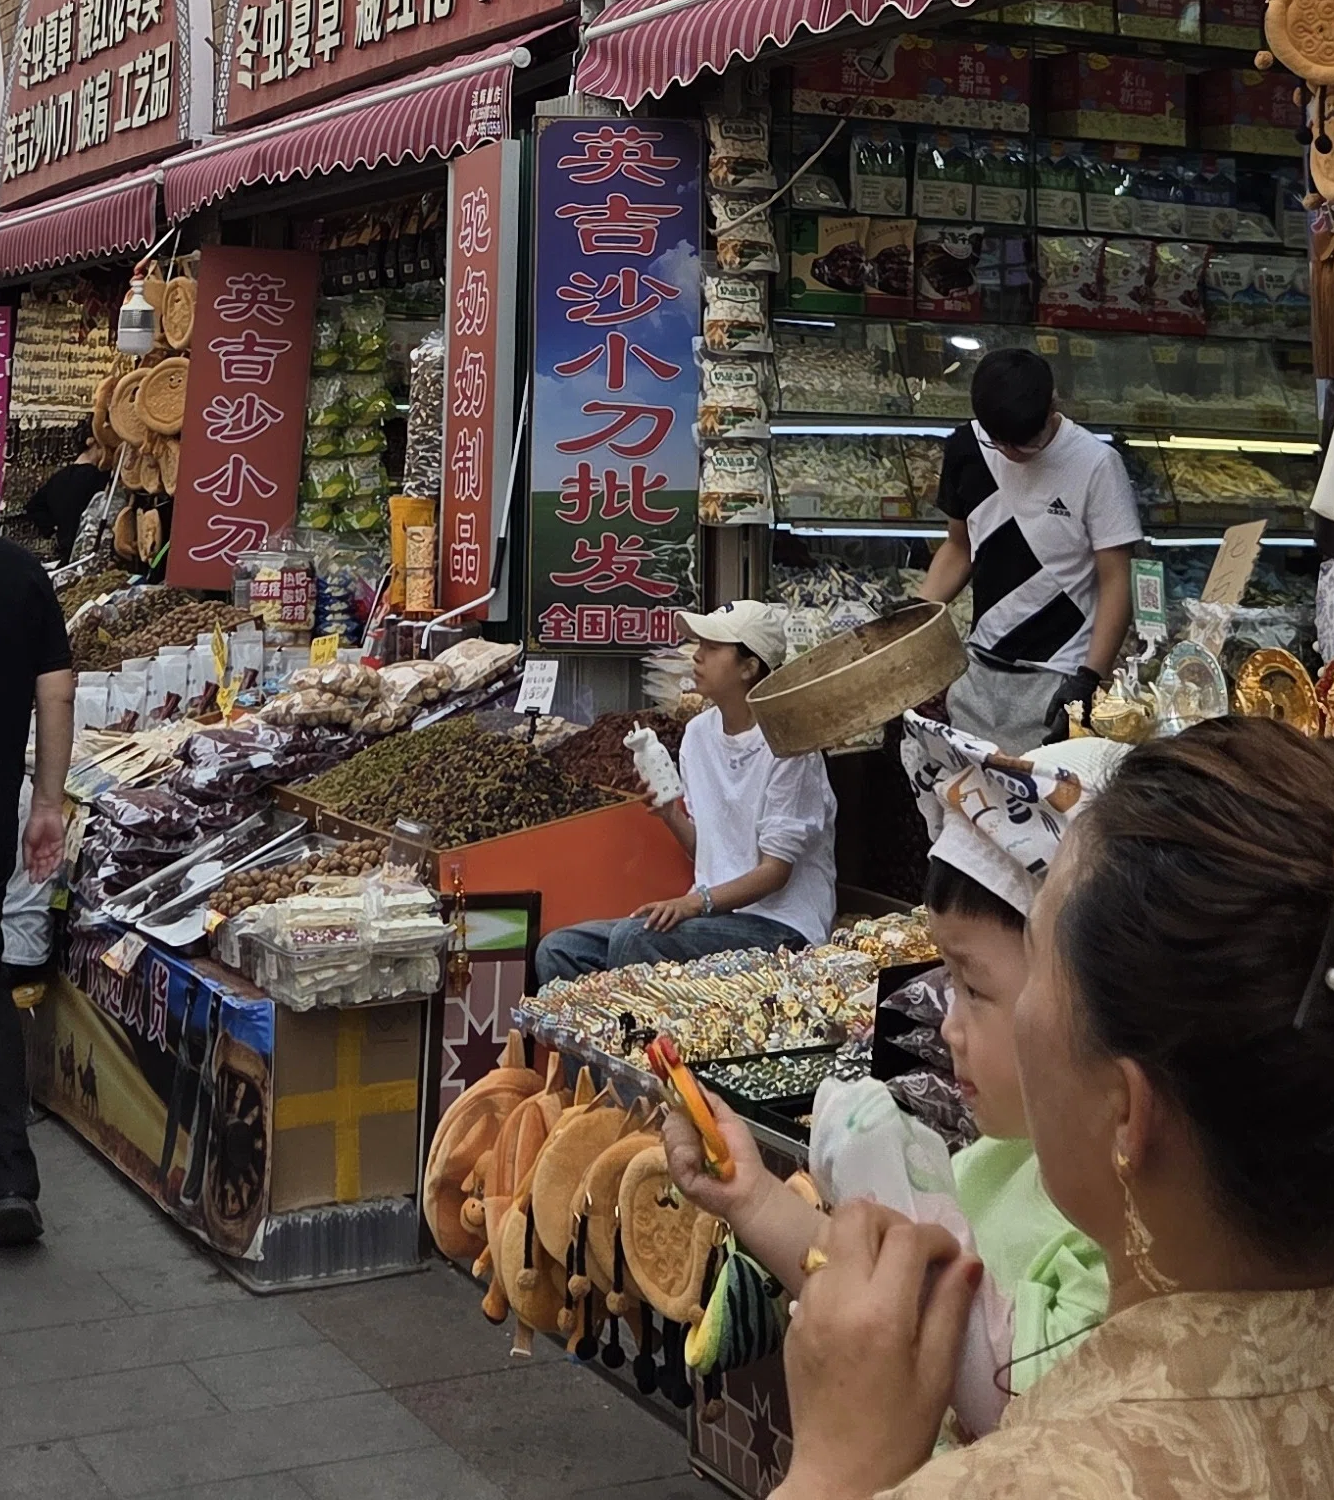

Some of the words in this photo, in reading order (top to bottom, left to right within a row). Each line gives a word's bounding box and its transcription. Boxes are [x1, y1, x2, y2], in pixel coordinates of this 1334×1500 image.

[3, 90, 74, 183] 英吉沙小刀
[76, 69, 112, 152] 披肩
[114, 41, 173, 133] 工艺品
[19, 0, 75, 90] 冬虫夏草
[189, 273, 295, 566] 英吉沙小刀
[449, 187, 491, 585] 驼奶奶制品
[550, 126, 683, 597] 英吉沙小刀批发
